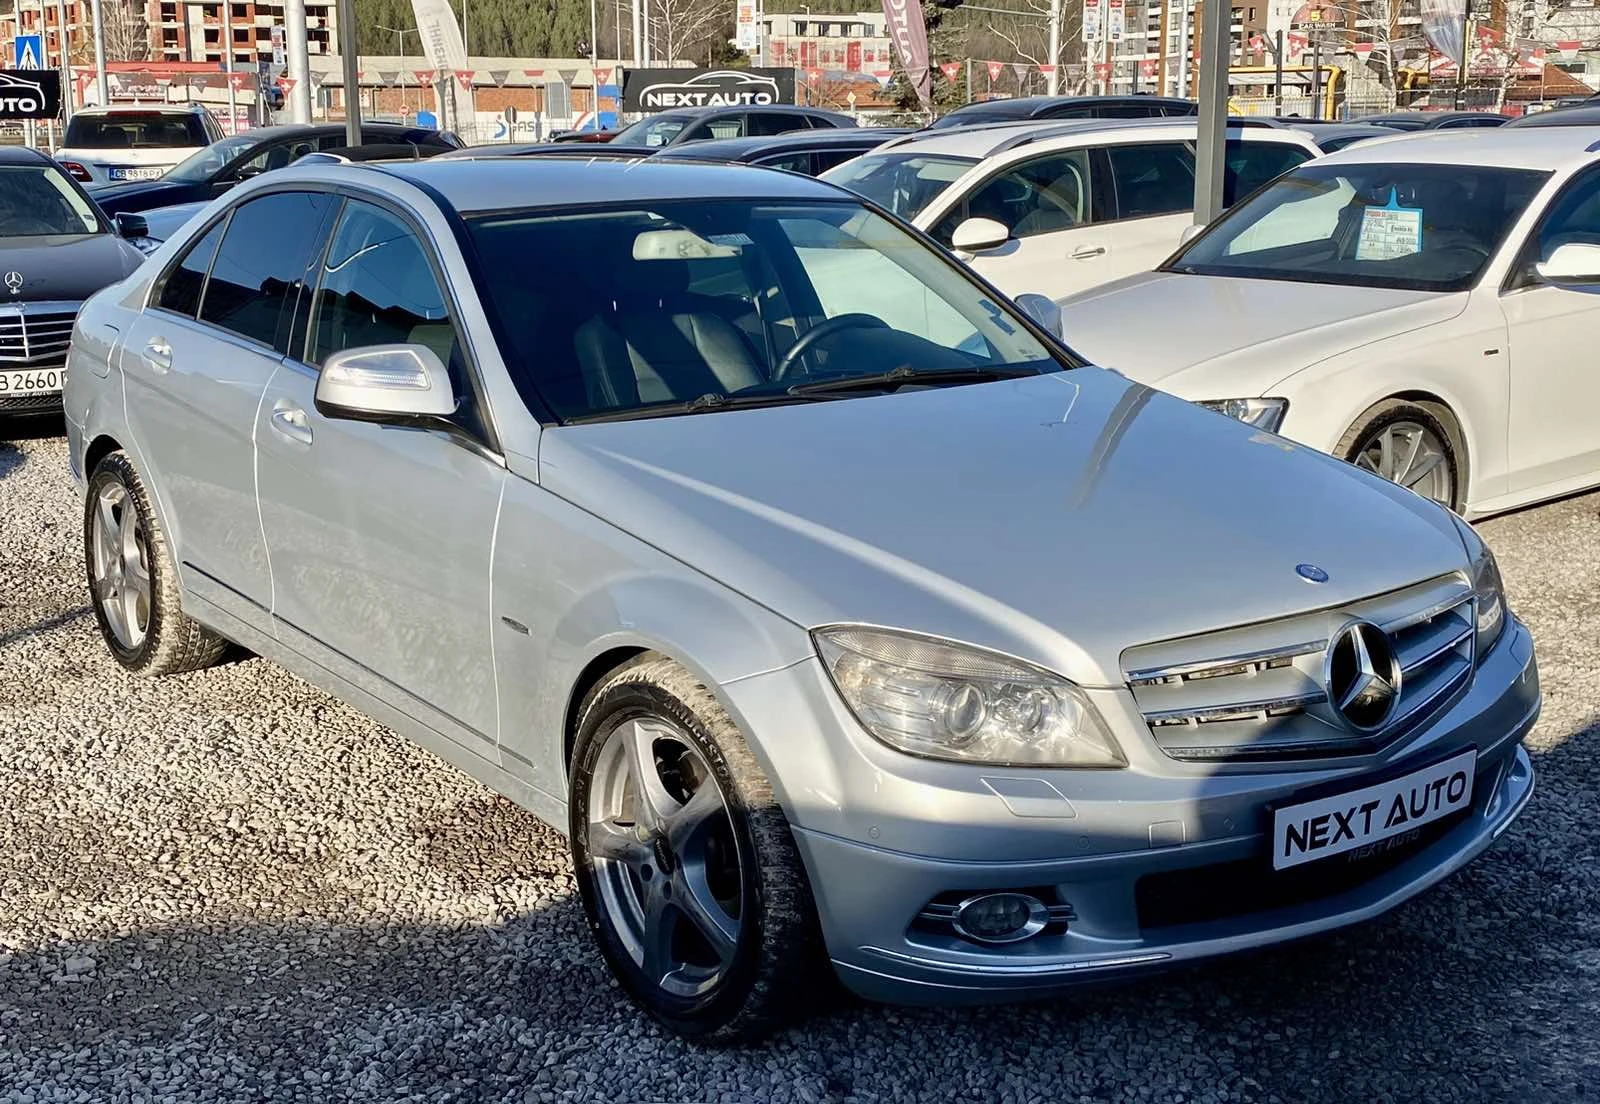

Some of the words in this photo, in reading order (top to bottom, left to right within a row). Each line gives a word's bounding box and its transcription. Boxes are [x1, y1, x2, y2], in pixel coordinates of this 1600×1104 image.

[0, 97, 37, 112] TO
[646, 92, 707, 107] NEXT
[707, 92, 772, 106] AUTO
[13, 371, 57, 390] 2660
[1284, 799, 1381, 857] NEXT
[1383, 770, 1467, 830] AUTO
